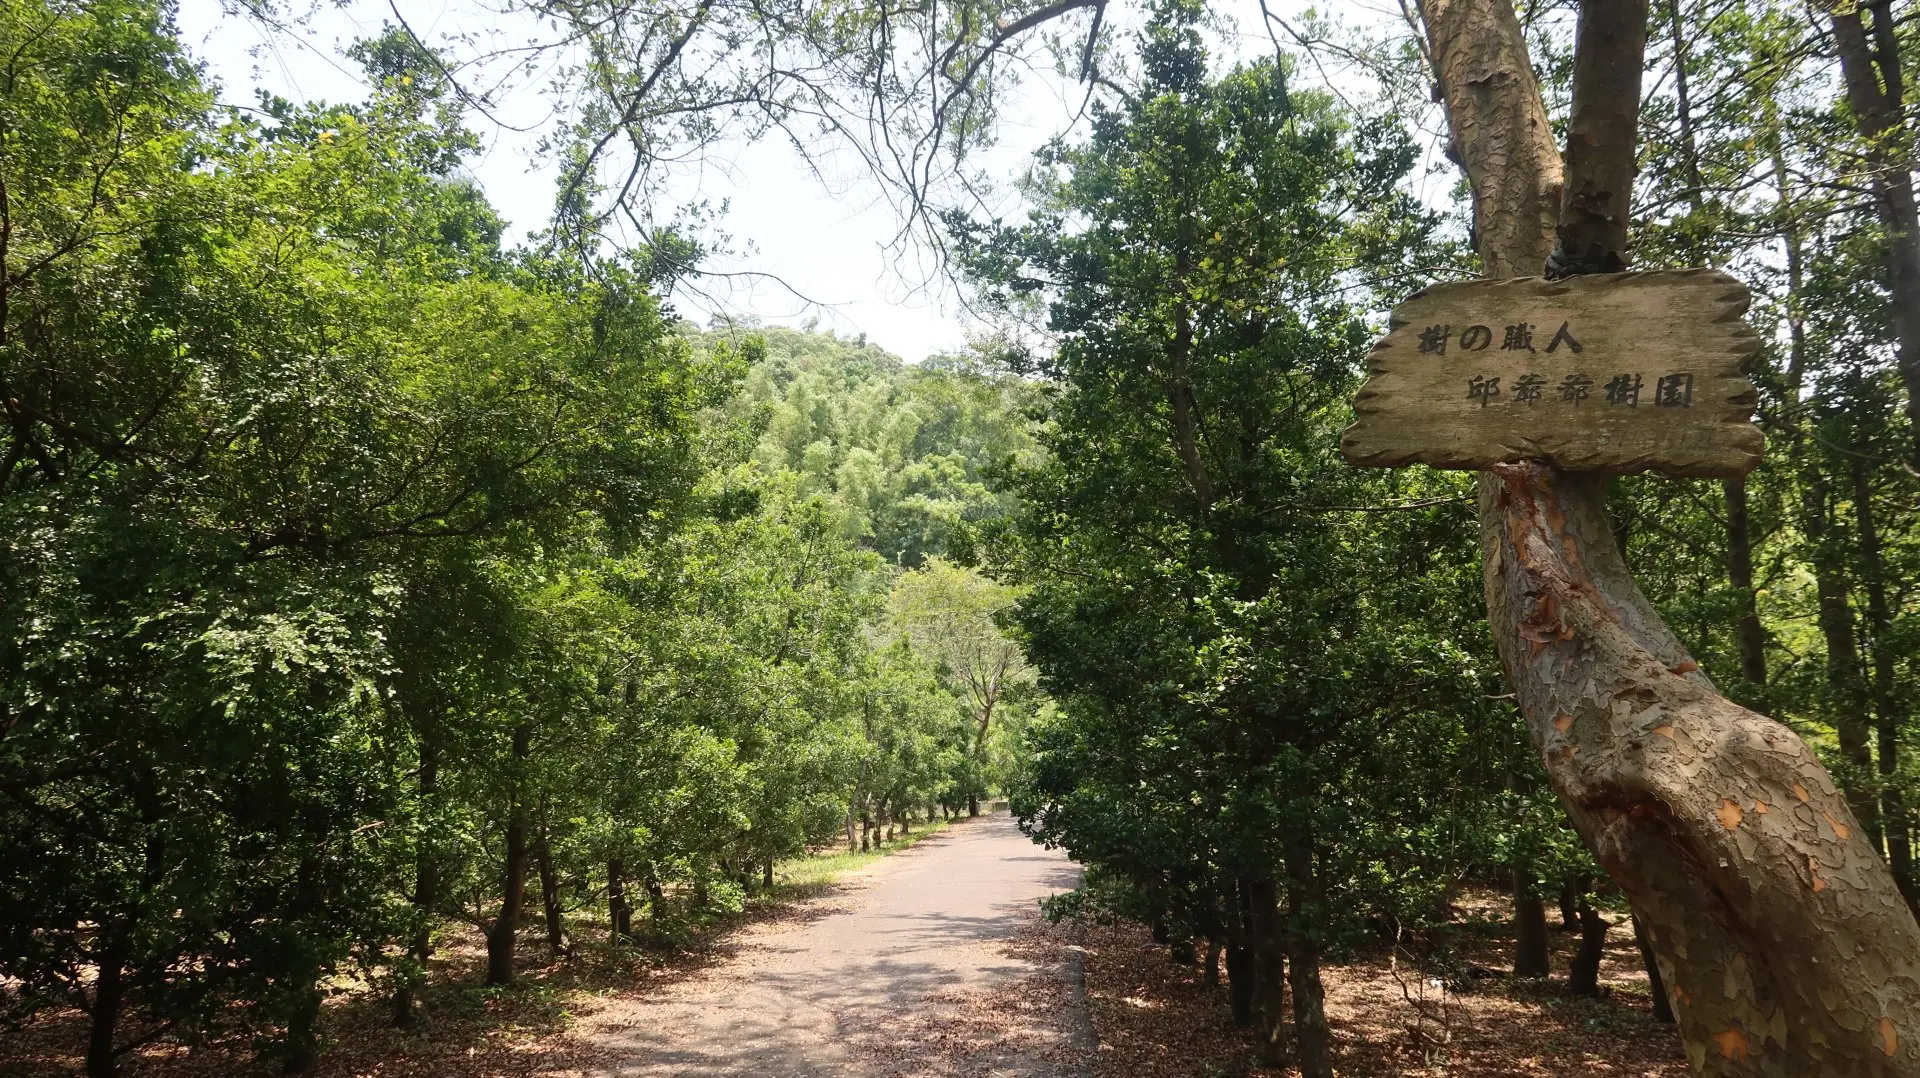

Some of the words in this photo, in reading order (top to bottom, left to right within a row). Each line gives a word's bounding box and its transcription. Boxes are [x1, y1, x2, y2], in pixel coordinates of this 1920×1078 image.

[1417, 320, 1584, 356] 樹の職人
[1466, 372, 1694, 409] 邱爺爺樹園
